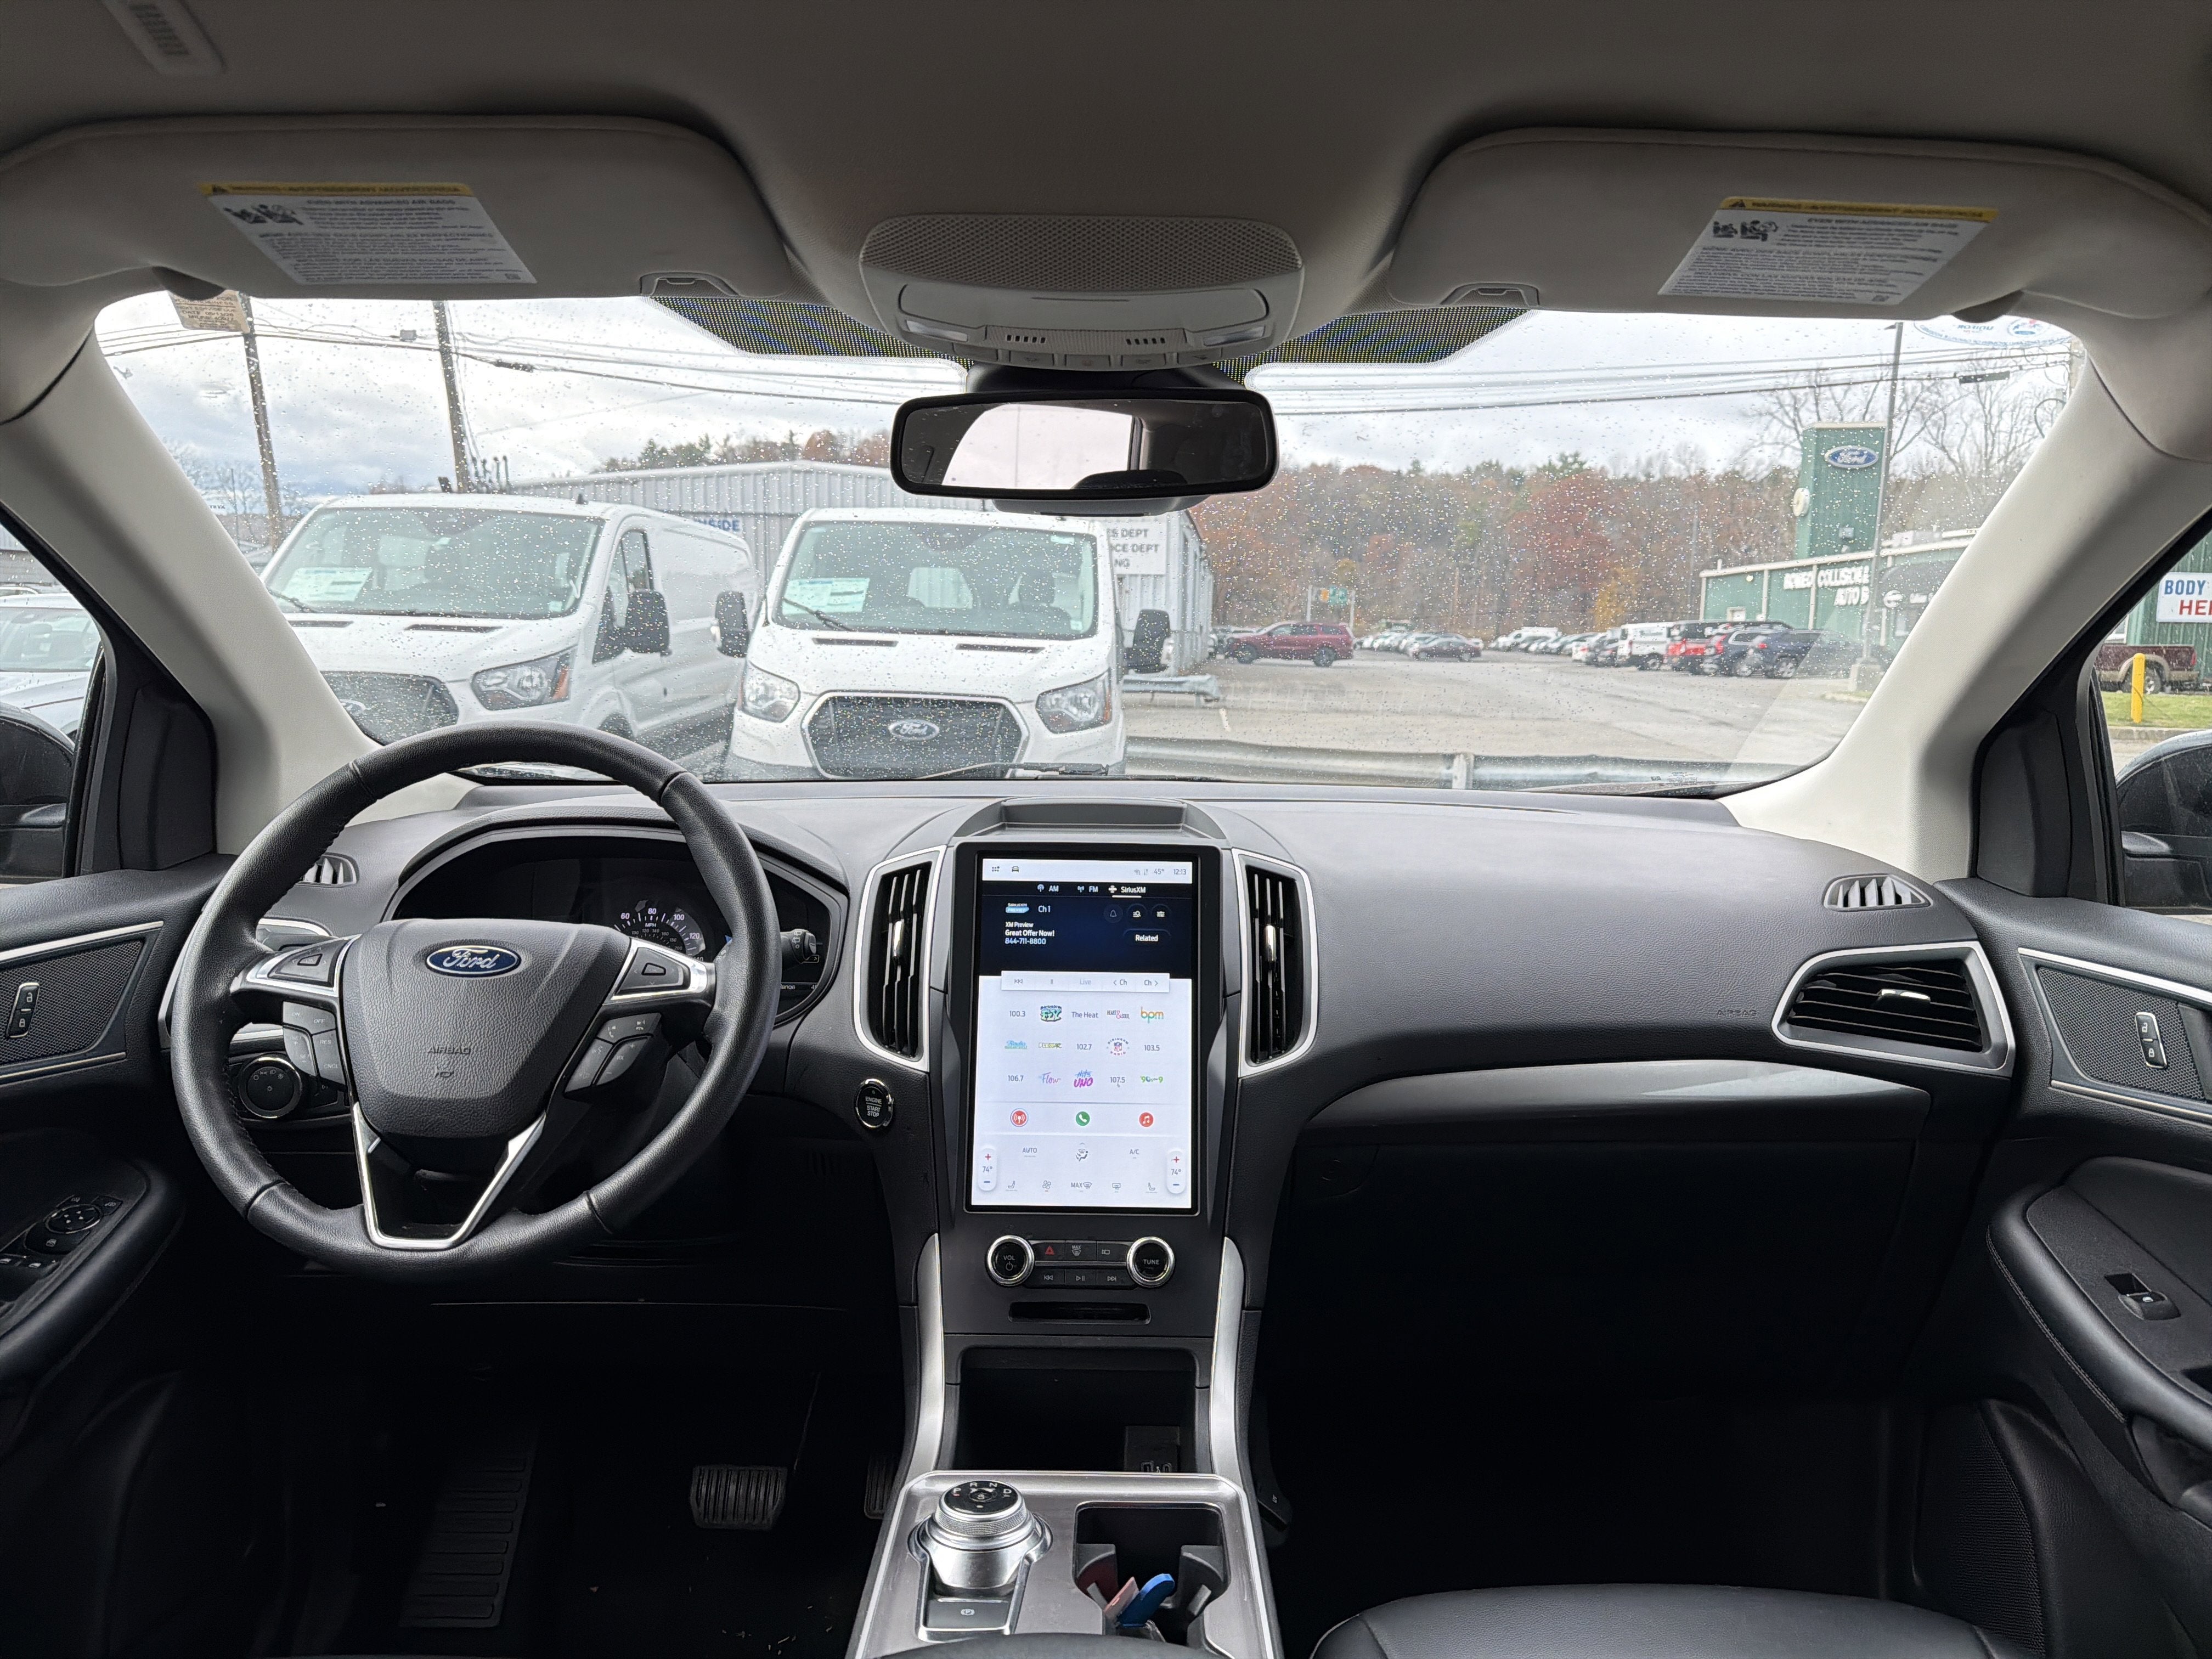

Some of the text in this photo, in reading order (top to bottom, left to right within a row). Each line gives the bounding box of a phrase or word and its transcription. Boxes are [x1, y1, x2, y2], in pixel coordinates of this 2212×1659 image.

[1131, 543, 1159, 553] DEPT
[2164, 580, 2207, 595] BODY
[442, 948, 500, 969] Ford
[1141, 1006, 1164, 1024] bpm
[427, 1046, 471, 1054] AIRBAG
[1074, 1077, 1093, 1088] UNO
[865, 1096, 882, 1104] ENGINE
